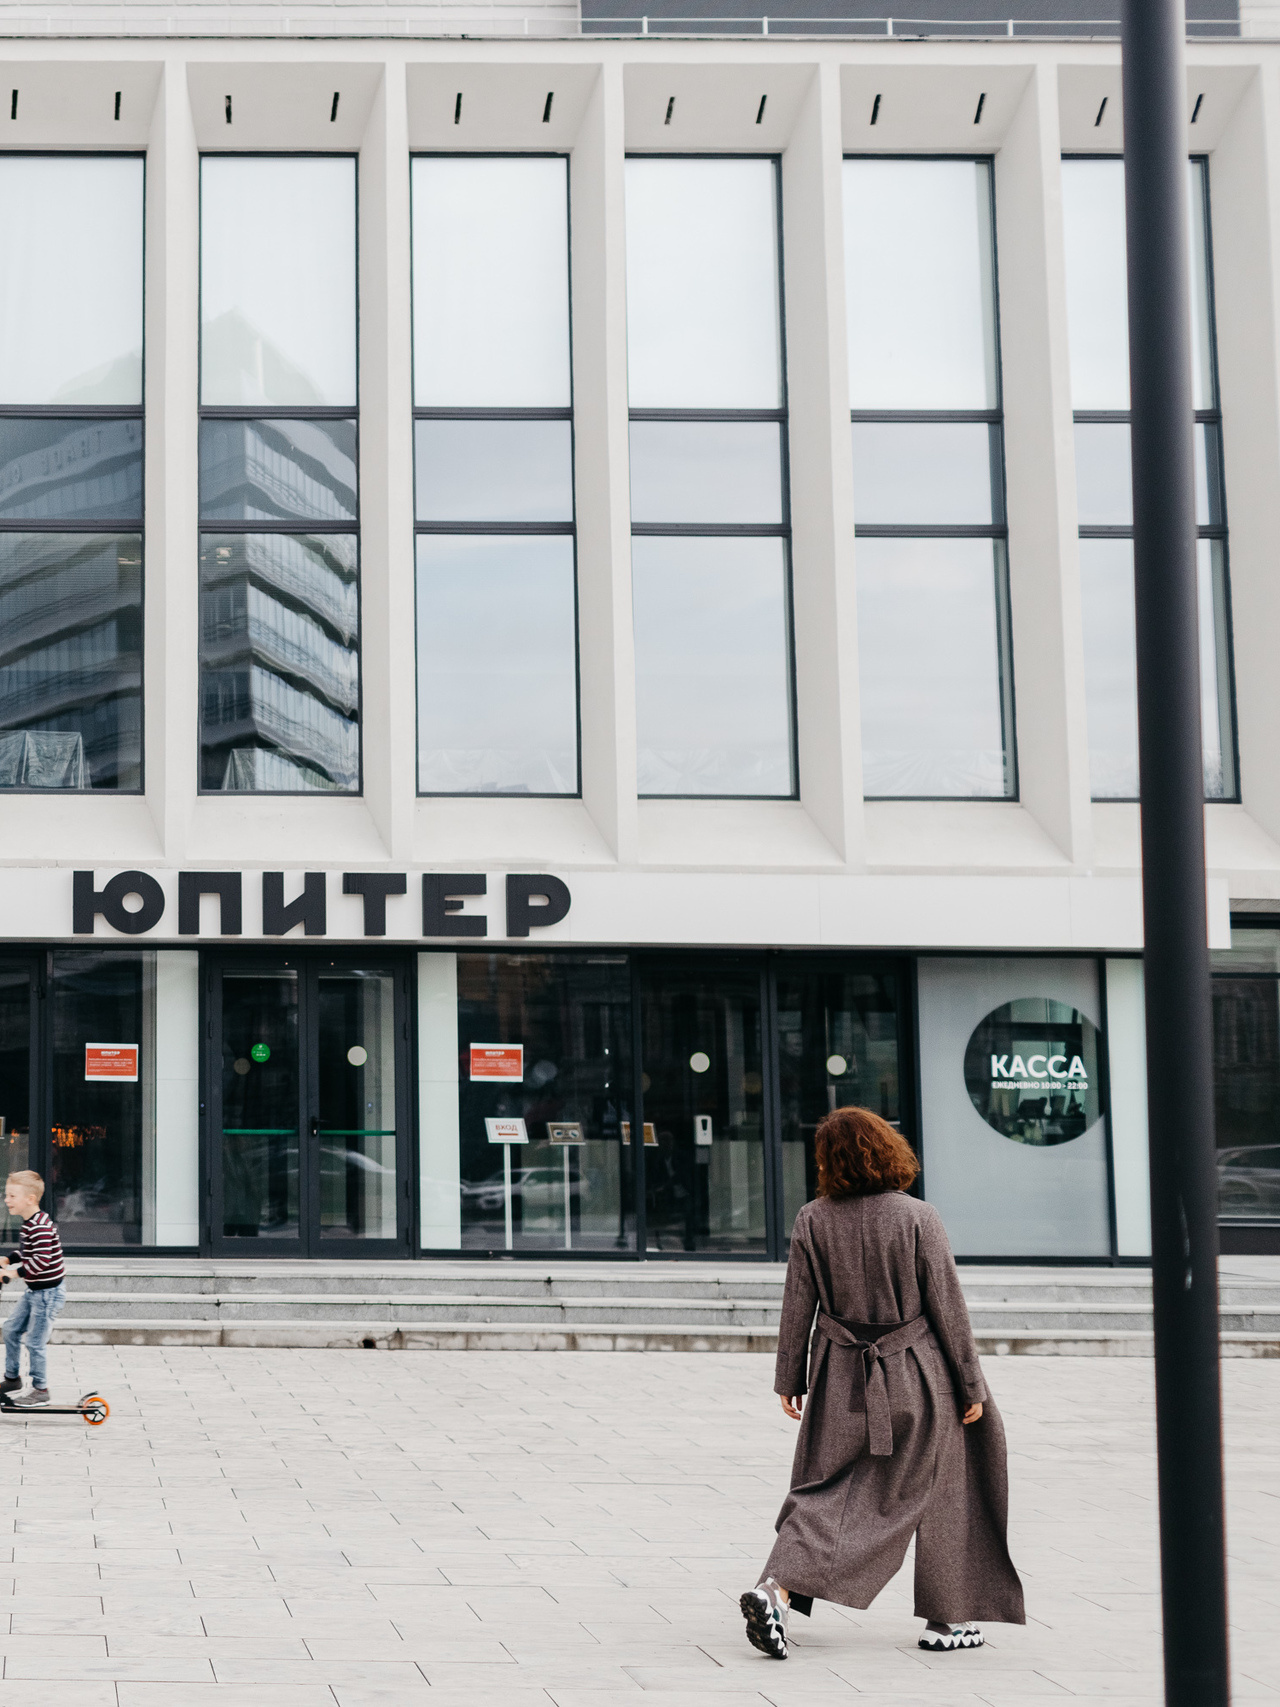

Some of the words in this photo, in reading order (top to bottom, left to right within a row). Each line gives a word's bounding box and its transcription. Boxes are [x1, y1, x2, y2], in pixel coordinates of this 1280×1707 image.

[73, 870, 571, 937] ЮПИТЕР
[991, 1054, 1088, 1078] КАССА
[991, 1081, 1040, 1090] ЕЖЕДНЕВНО
[1040, 1081, 1062, 1090] 10:00
[1067, 1081, 1089, 1090] 22:00
